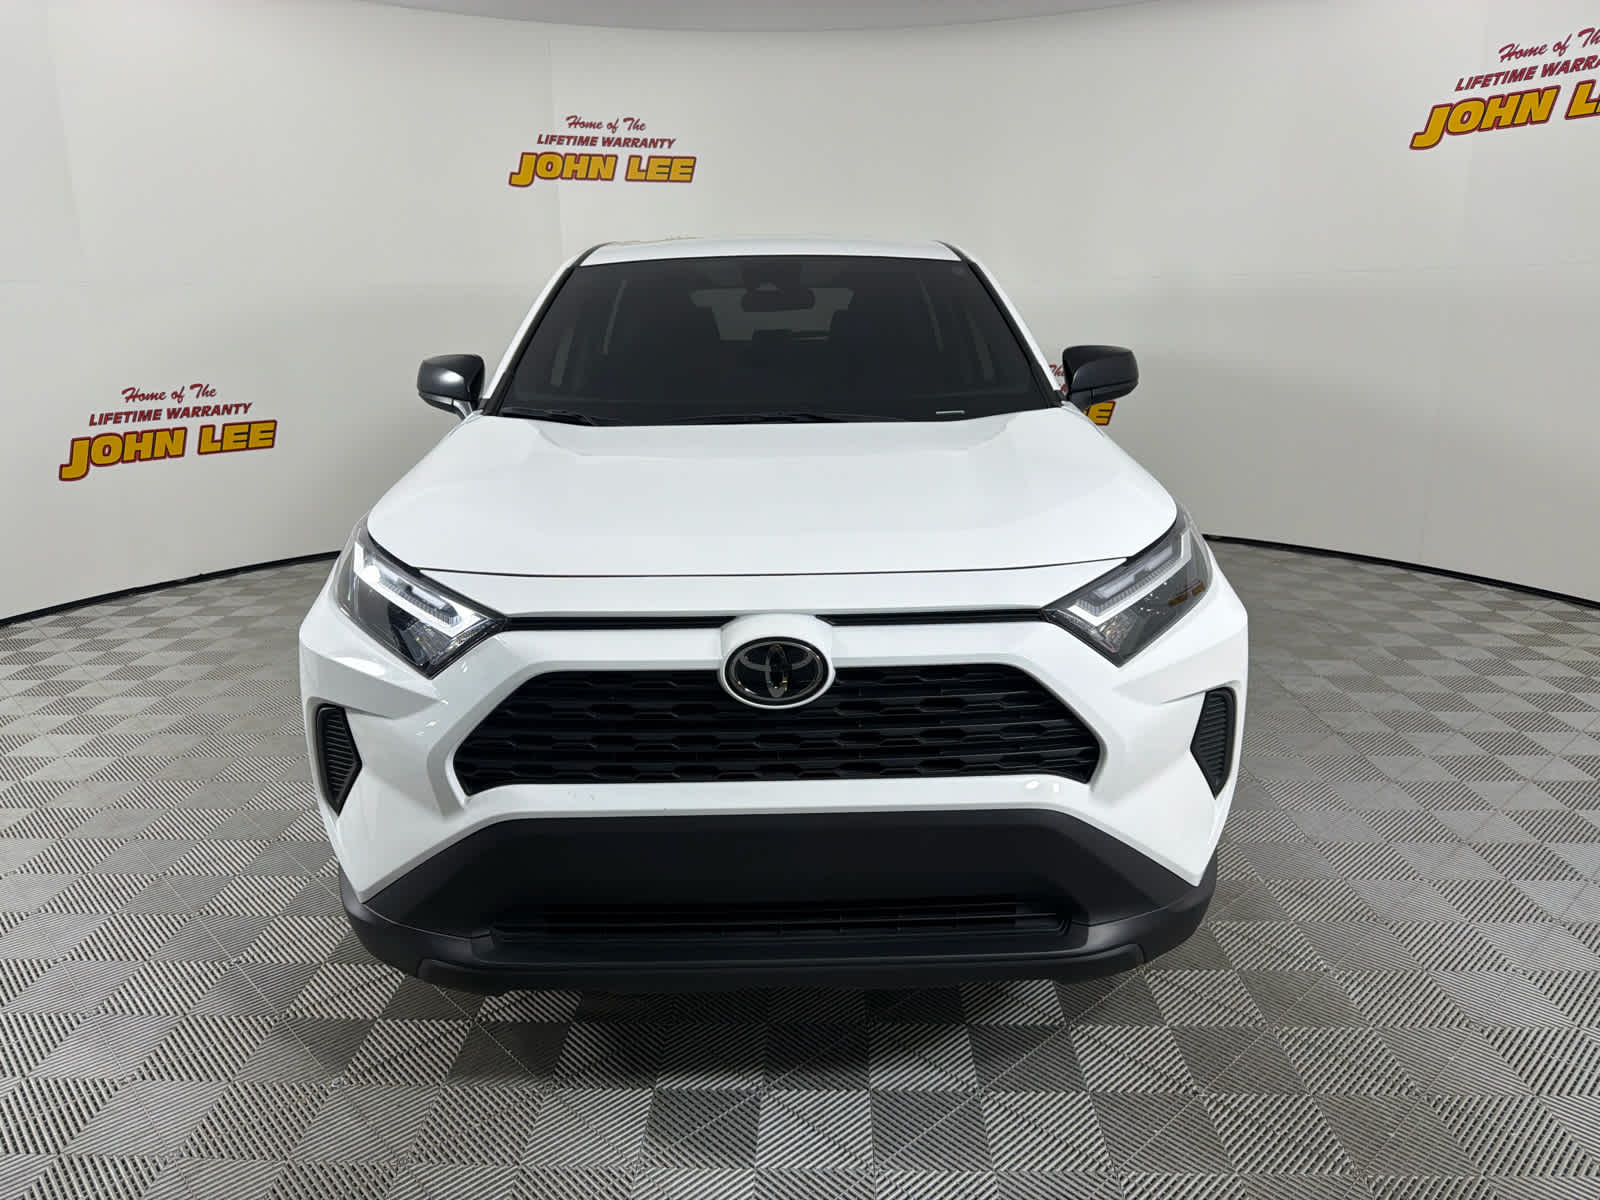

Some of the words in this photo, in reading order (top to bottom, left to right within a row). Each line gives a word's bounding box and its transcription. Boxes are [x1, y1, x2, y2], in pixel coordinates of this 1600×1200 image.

[1498, 43, 1548, 62] Home
[1552, 33, 1572, 56] of
[1455, 65, 1538, 92] LIFETIME
[566, 115, 603, 129] Home
[606, 117, 619, 134] of
[623, 117, 646, 132] The
[1409, 85, 1561, 150] JOHN
[537, 134, 598, 147] LIFETIME
[602, 136, 676, 149] WARRANTY
[509, 152, 618, 187] JOHN
[625, 155, 696, 183] LEE
[121, 387, 167, 403] Home
[170, 386, 185, 403] of
[189, 384, 217, 398] The
[89, 409, 162, 426] LIFETIME
[166, 403, 252, 419] WARRANTY
[59, 427, 188, 481] JOHN
[197, 420, 277, 455] LEE
